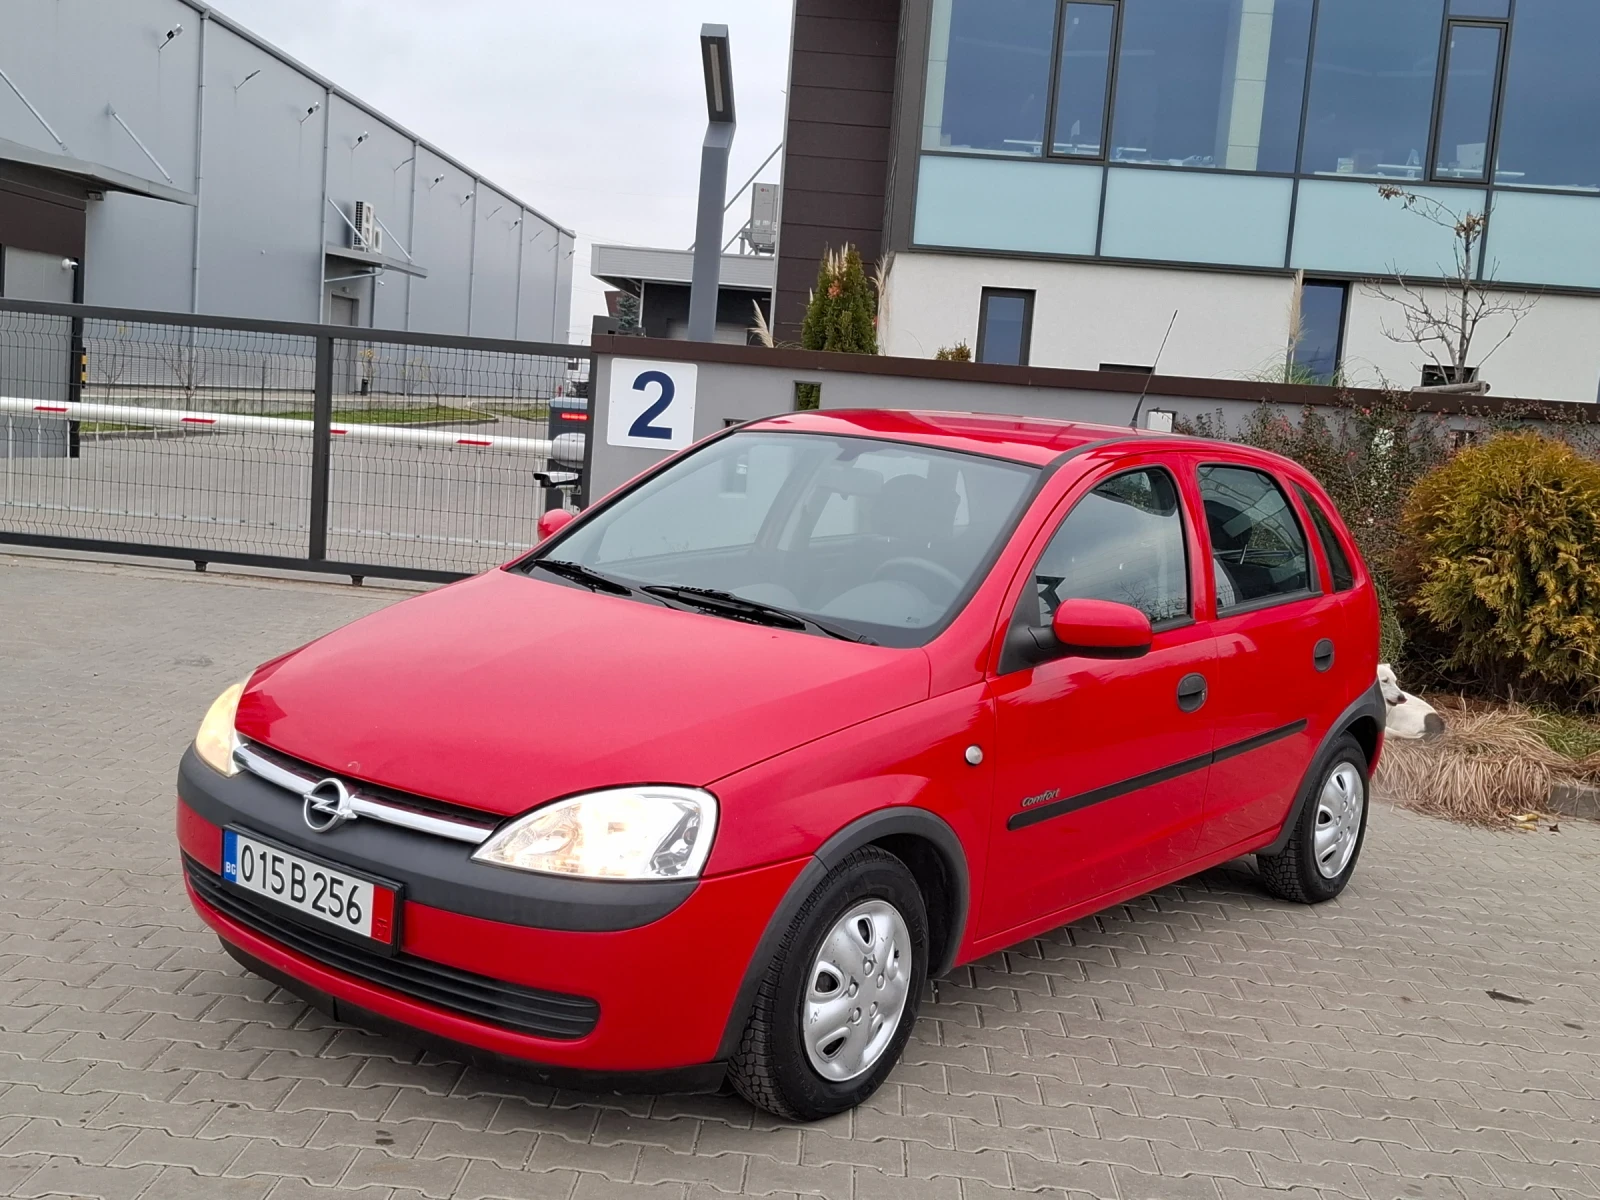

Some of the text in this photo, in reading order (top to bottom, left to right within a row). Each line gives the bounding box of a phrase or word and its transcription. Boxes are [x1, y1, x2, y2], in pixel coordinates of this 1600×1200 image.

[627, 370, 675, 440] 2
[1022, 787, 1060, 807] Comfort
[225, 861, 236, 876] BG
[241, 844, 362, 925] 015B256
